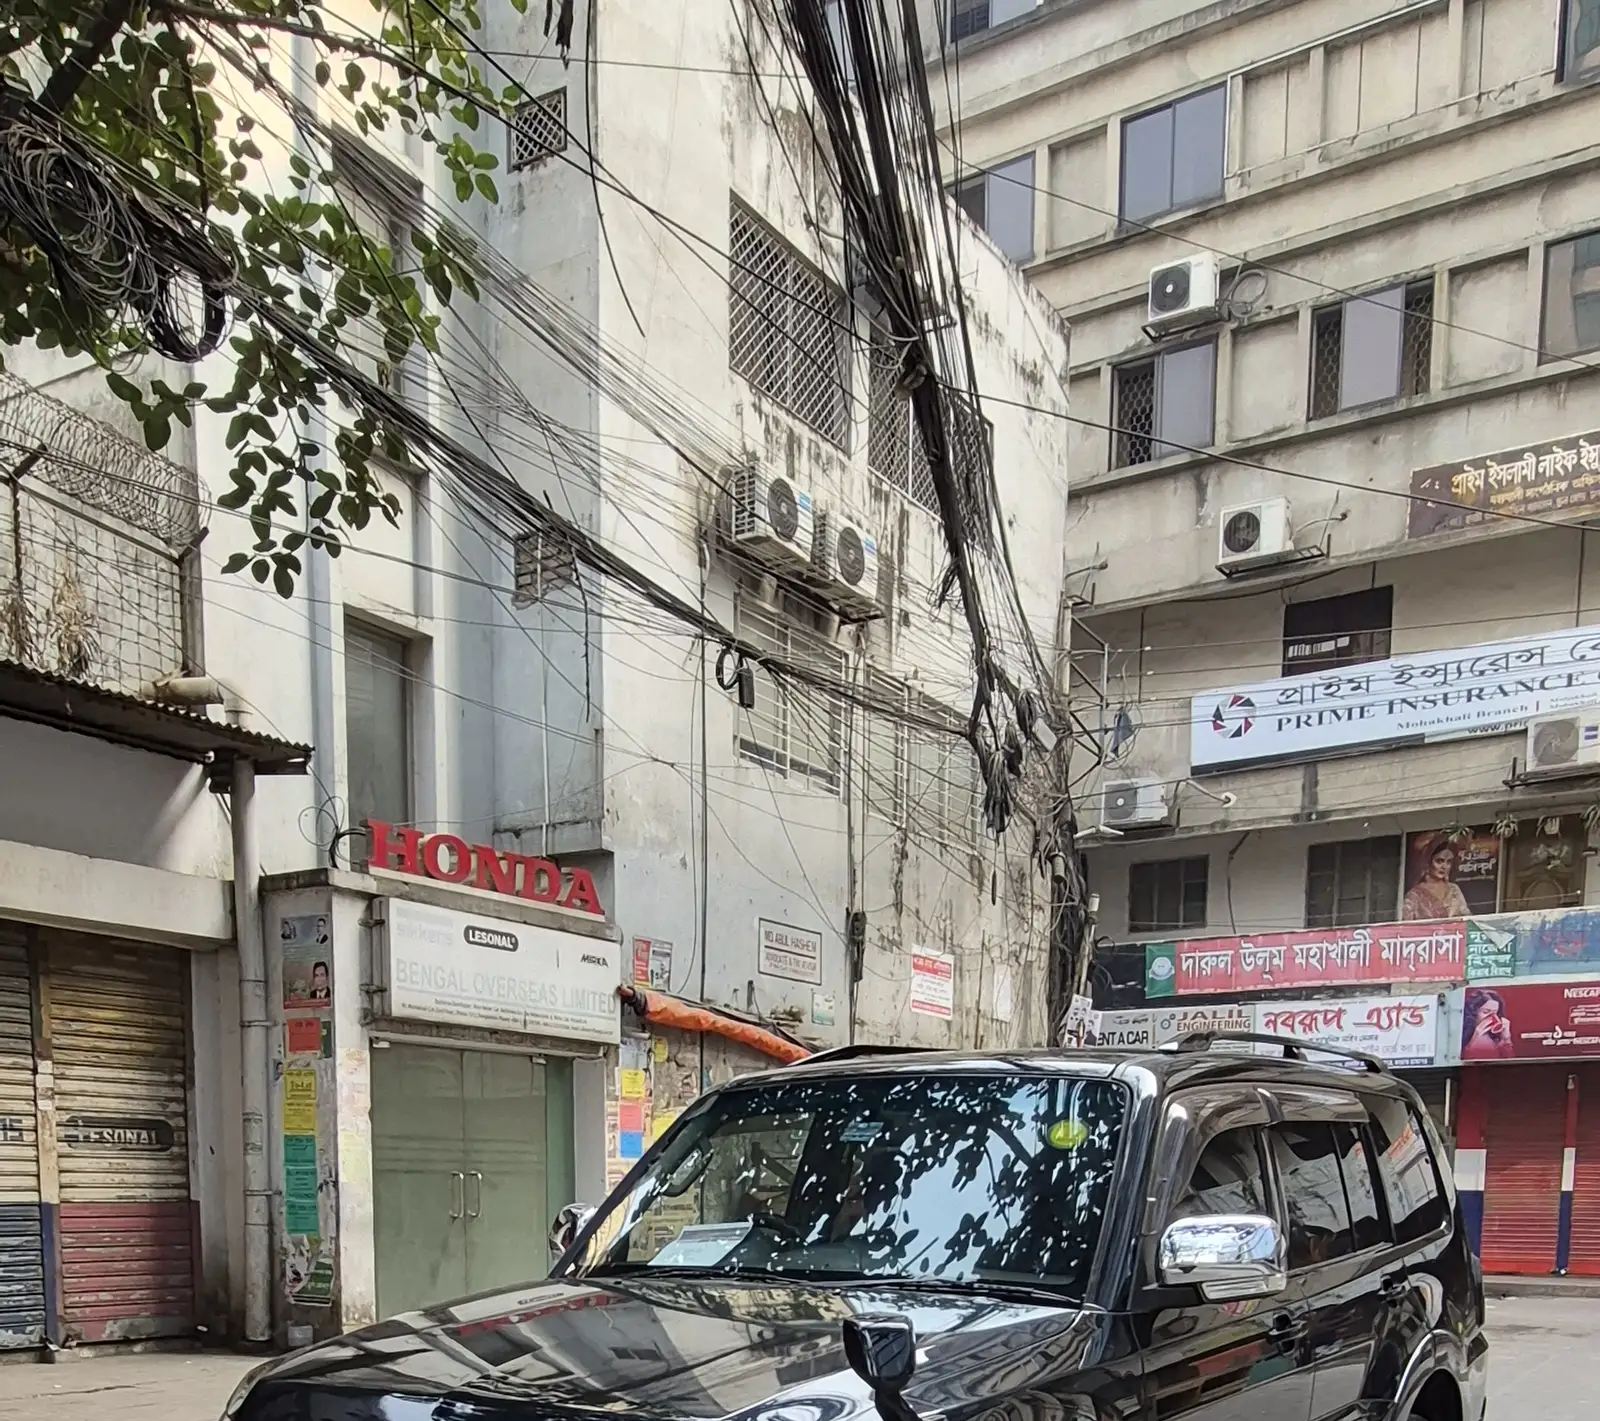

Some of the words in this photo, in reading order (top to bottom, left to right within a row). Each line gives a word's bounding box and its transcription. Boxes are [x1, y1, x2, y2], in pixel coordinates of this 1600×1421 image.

[1451, 464, 1485, 495] প্রাইম
[1486, 458, 1537, 490] ইসলামী
[1537, 445, 1578, 478] লাইফ
[1276, 703, 1376, 732] PRIME
[1387, 670, 1587, 715] INSURANCE
[1277, 675, 1376, 706] প্রাইম
[1397, 712, 1452, 731] Mohakhali
[1476, 703, 1529, 720] Branch
[367, 818, 606, 917] HONDA
[469, 929, 514, 949] LESONAL
[1180, 949, 1235, 979] দারুল
[1292, 928, 1374, 974] মহাখালী
[396, 957, 469, 992] BENGAL
[473, 972, 558, 1006] OVERSEAS
[562, 986, 617, 1015] LIMITED
[1176, 1009, 1251, 1021] JALIL
[1176, 1019, 1252, 1032] ENGINEERING
[1262, 1006, 1348, 1035] নবরূপ
[1117, 1032, 1126, 1045] A
[1126, 1030, 1149, 1045] CAR
